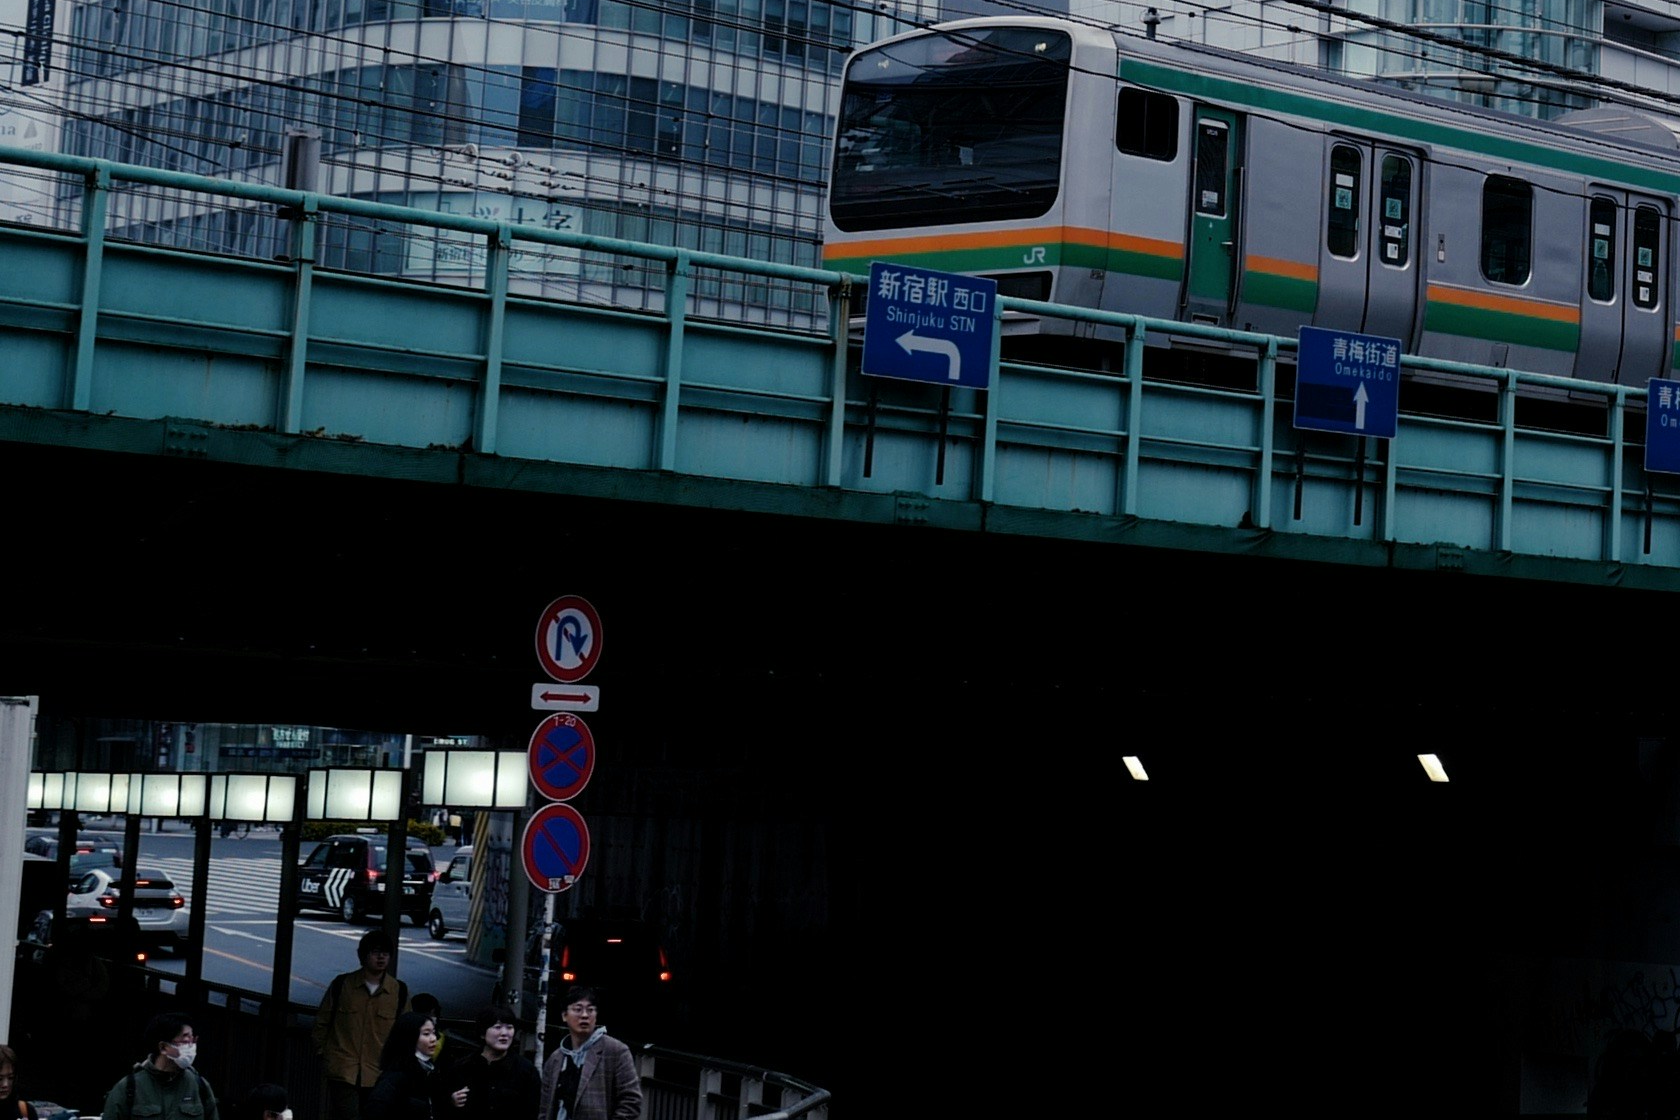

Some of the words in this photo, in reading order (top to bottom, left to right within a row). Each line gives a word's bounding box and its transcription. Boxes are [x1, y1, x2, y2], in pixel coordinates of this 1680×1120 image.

[1022, 246, 1046, 265] JR
[886, 305, 945, 329] Shinjuku
[948, 315, 977, 334] STN
[1332, 337, 1398, 368] 青梅街道
[1334, 362, 1393, 382] Omekaido
[300, 877, 320, 894] Uber
